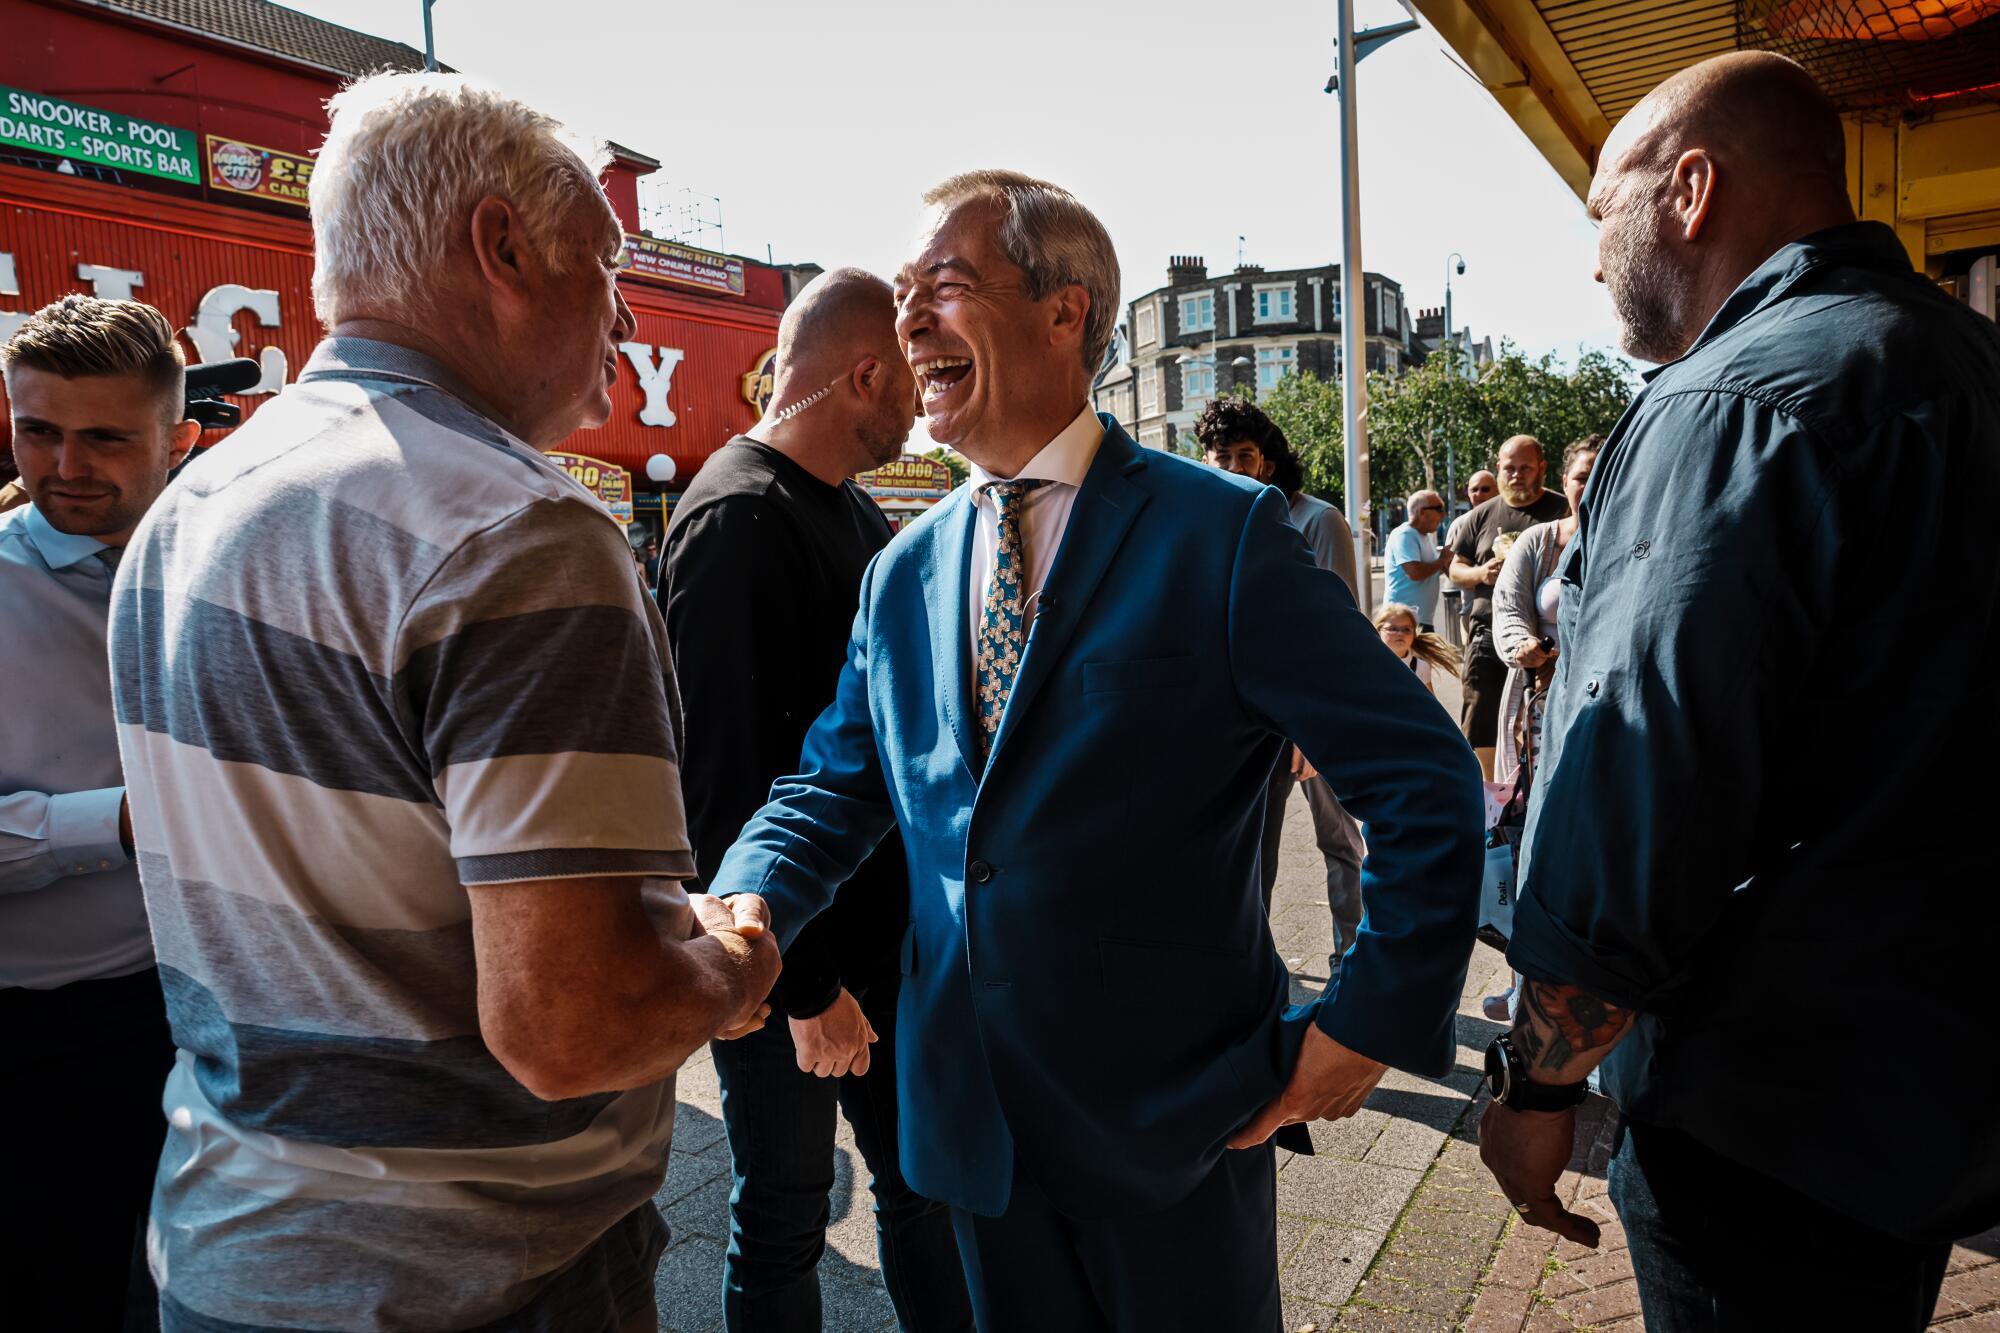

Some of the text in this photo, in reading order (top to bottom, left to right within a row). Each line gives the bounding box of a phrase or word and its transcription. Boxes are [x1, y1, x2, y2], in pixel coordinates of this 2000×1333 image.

[8, 92, 113, 135] SNOOKER
[128, 121, 181, 151] POOL
[0, 116, 65, 149] DARTS
[81, 136, 153, 168] SPORTS
[157, 153, 193, 177] BAR
[213, 152, 262, 167] MAGIC
[222, 165, 257, 178] CITY
[269, 158, 314, 185] £5
[633, 252, 727, 280] NEW ONLINE CASINO
[1497, 881, 1507, 905] Dealz
